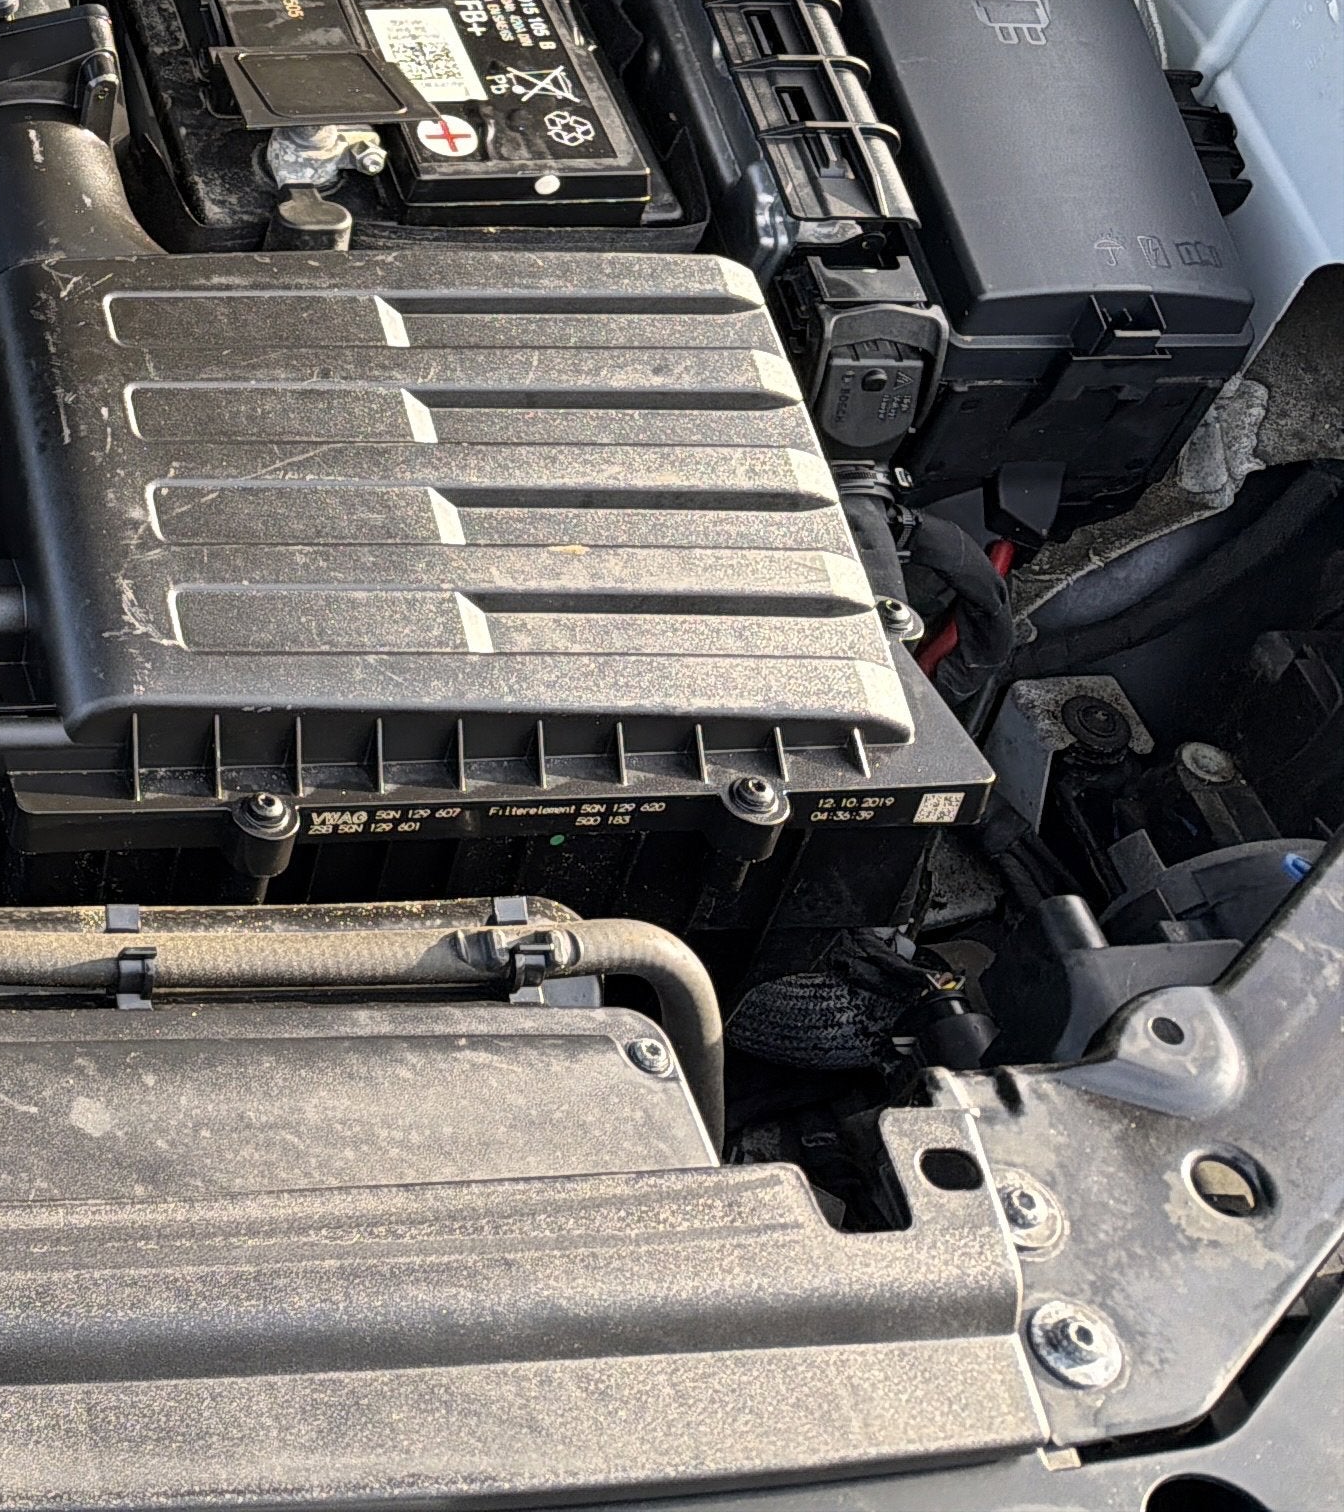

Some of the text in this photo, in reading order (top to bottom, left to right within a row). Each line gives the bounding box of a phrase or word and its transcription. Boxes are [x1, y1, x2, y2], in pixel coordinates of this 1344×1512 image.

[527, 15, 550, 38] 105
[486, 74, 510, 95] Pb
[489, 805, 576, 816] Filterelement
[612, 802, 636, 812] 129
[640, 802, 667, 812] 620
[818, 796, 895, 808] 12.10.2019
[311, 811, 369, 825] VWAG
[408, 808, 432, 819] 129
[435, 807, 462, 818] 607
[608, 815, 631, 825] 183
[370, 822, 393, 833] 129
[397, 821, 421, 832] 601
